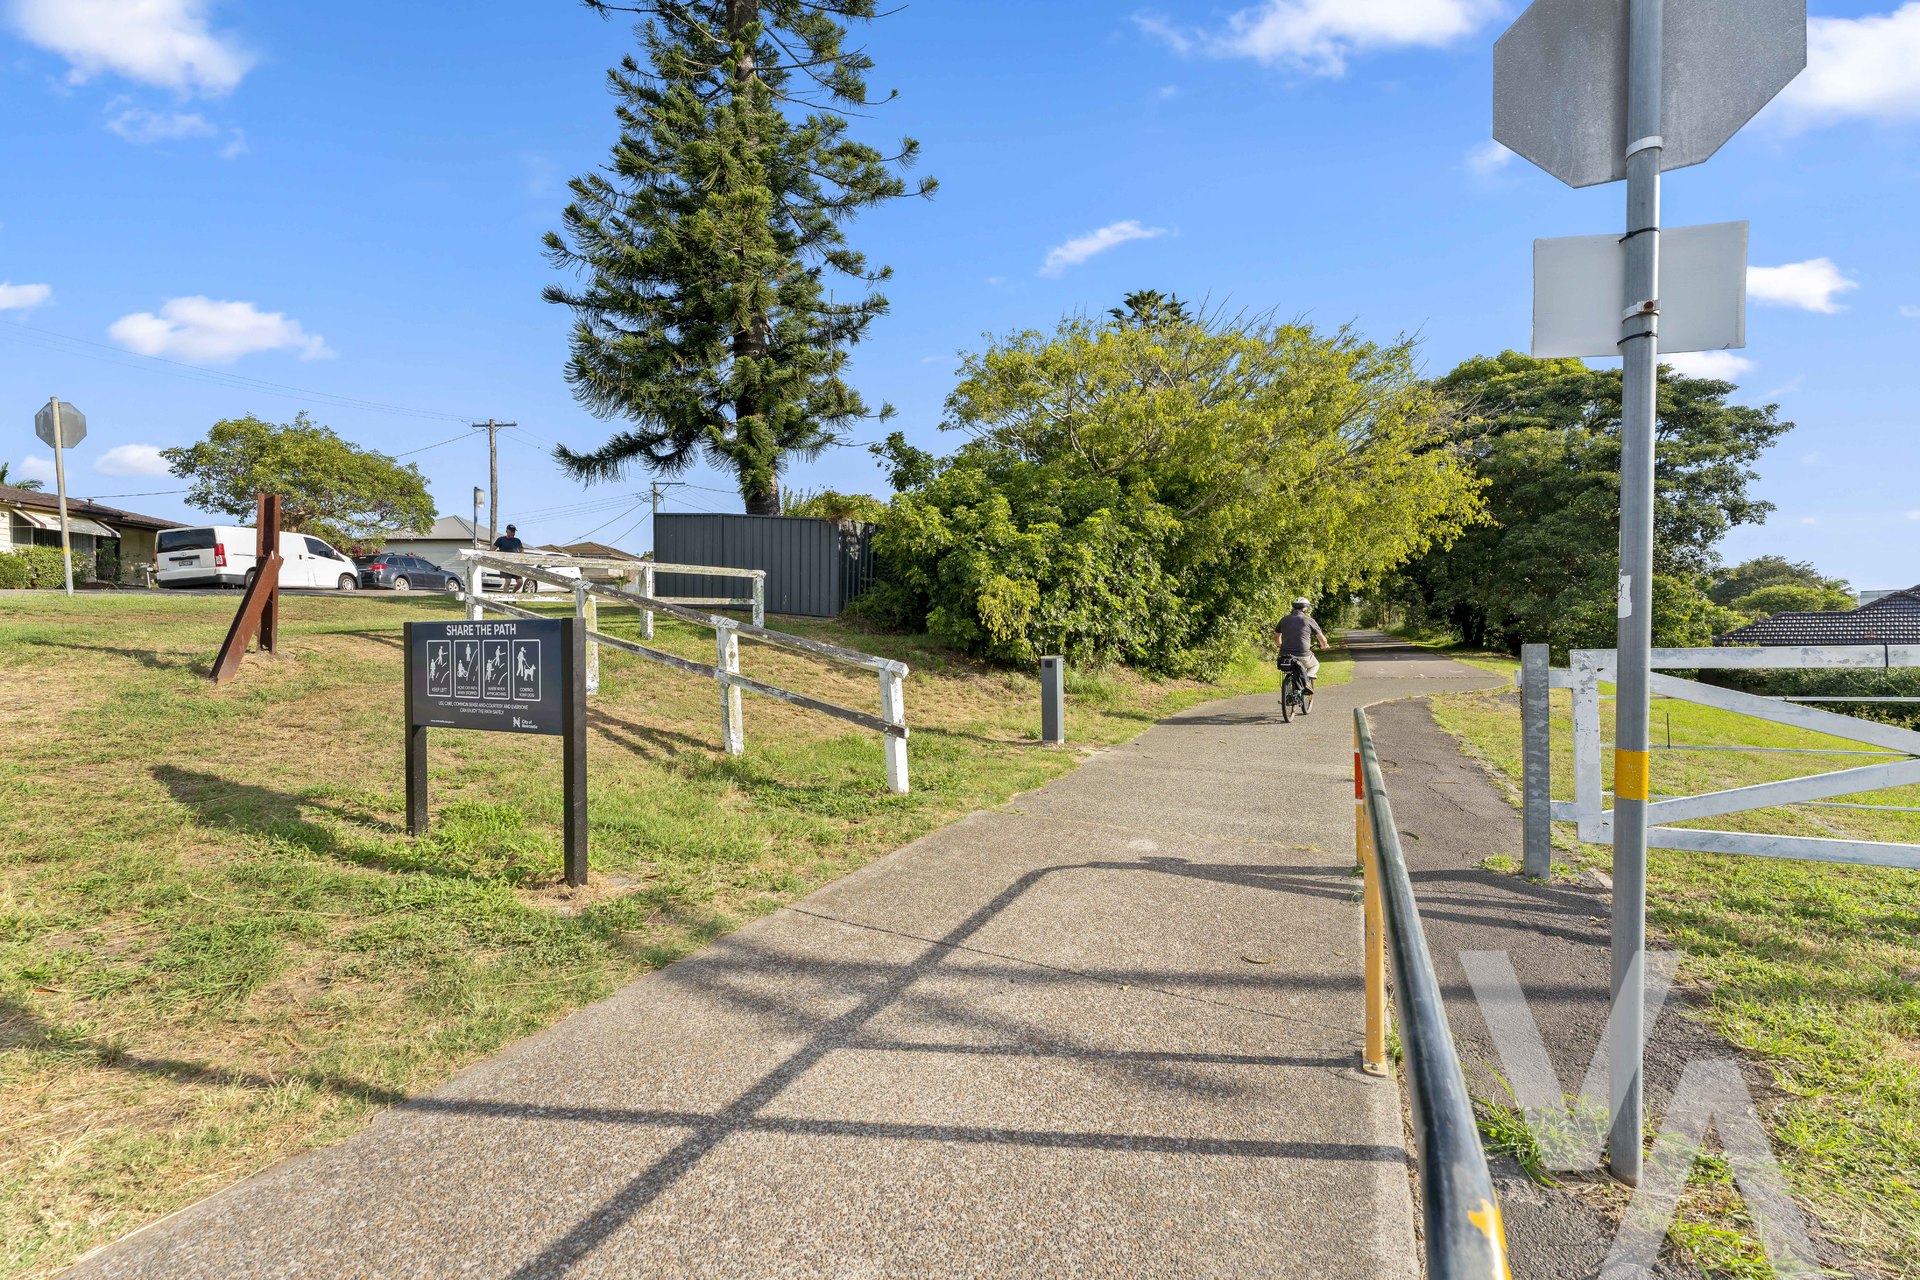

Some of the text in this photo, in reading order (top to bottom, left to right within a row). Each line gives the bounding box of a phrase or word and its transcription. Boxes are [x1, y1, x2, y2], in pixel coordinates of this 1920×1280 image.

[446, 624, 516, 636] SHARE THE PATH
